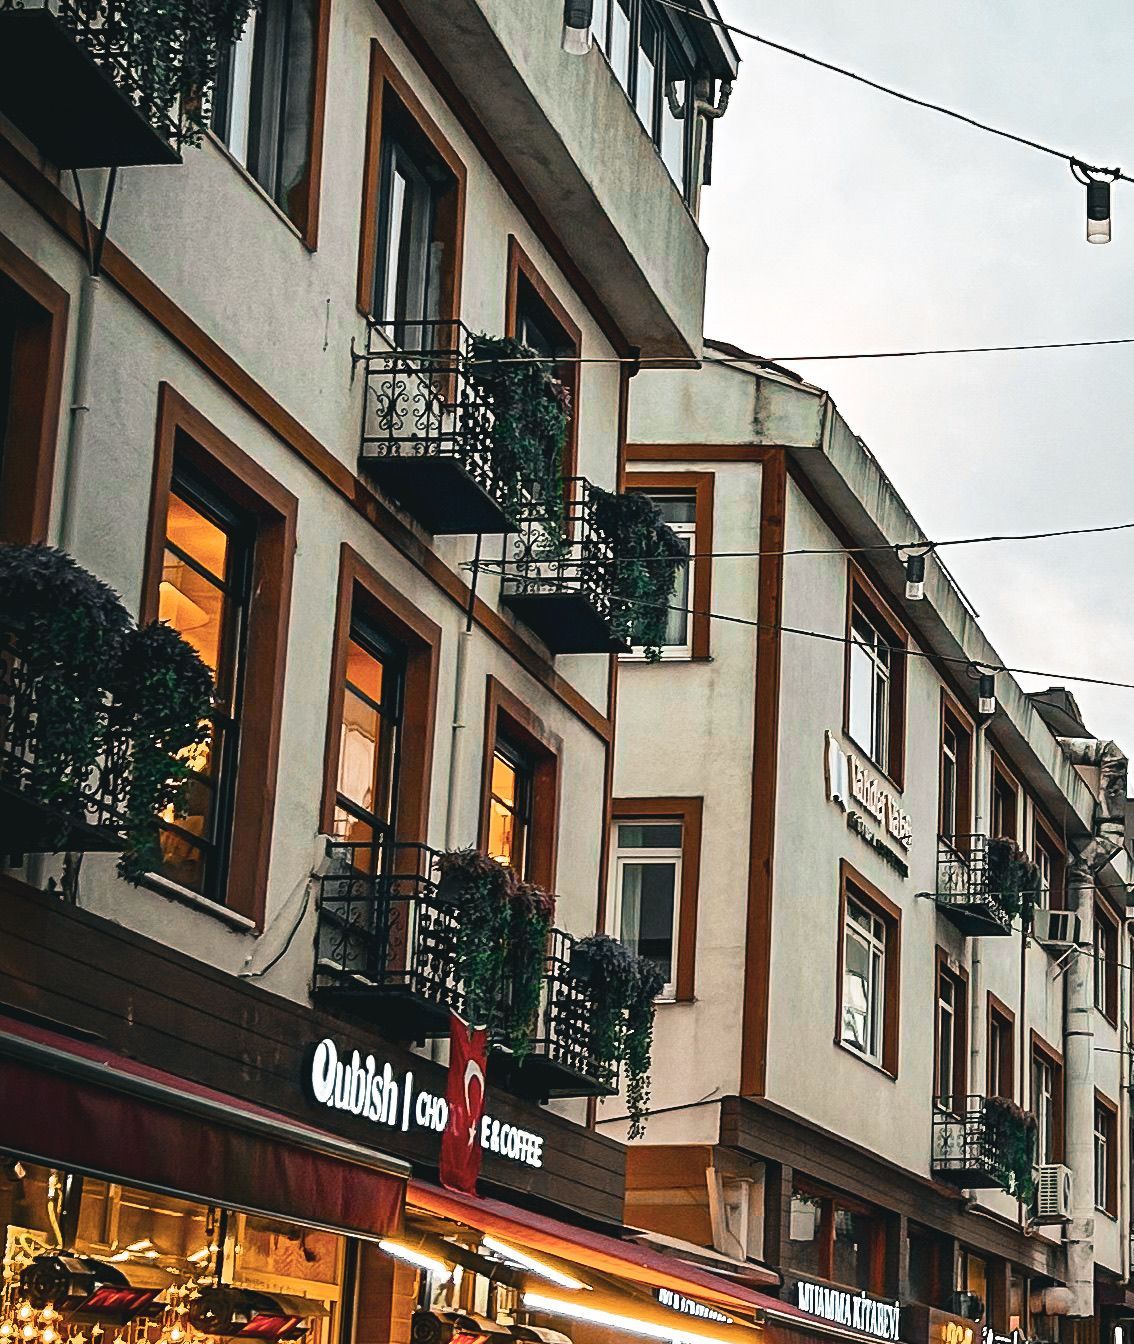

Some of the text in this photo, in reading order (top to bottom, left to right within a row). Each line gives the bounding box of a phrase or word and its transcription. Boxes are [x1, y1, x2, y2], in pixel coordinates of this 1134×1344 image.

[311, 1038, 399, 1126] Qubish
[499, 1123, 544, 1169] COFFEE
[797, 1281, 900, 1342] MUAMMA KİTABEVİ
